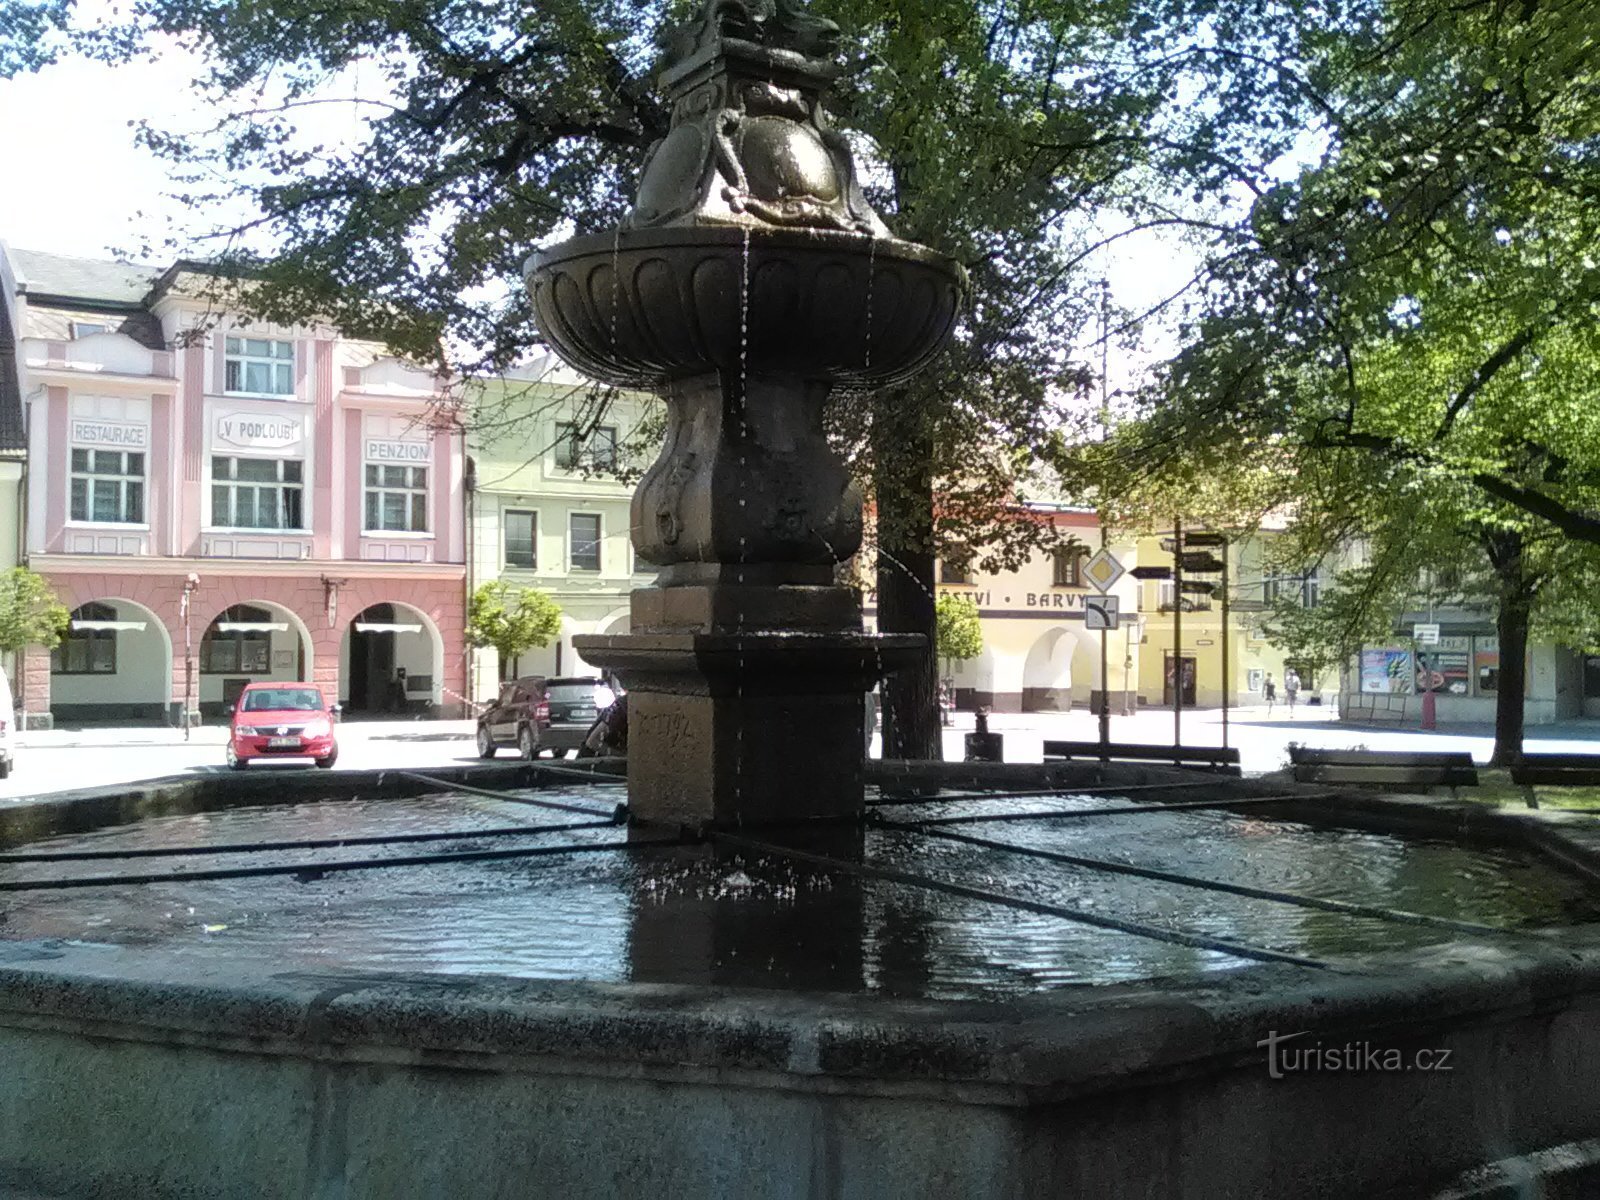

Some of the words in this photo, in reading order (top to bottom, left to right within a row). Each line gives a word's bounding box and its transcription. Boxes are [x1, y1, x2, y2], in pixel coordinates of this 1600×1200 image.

[75, 424, 144, 444] RESTAURACE
[369, 443, 430, 459] PENZION
[1026, 592, 1086, 608] BARVY
